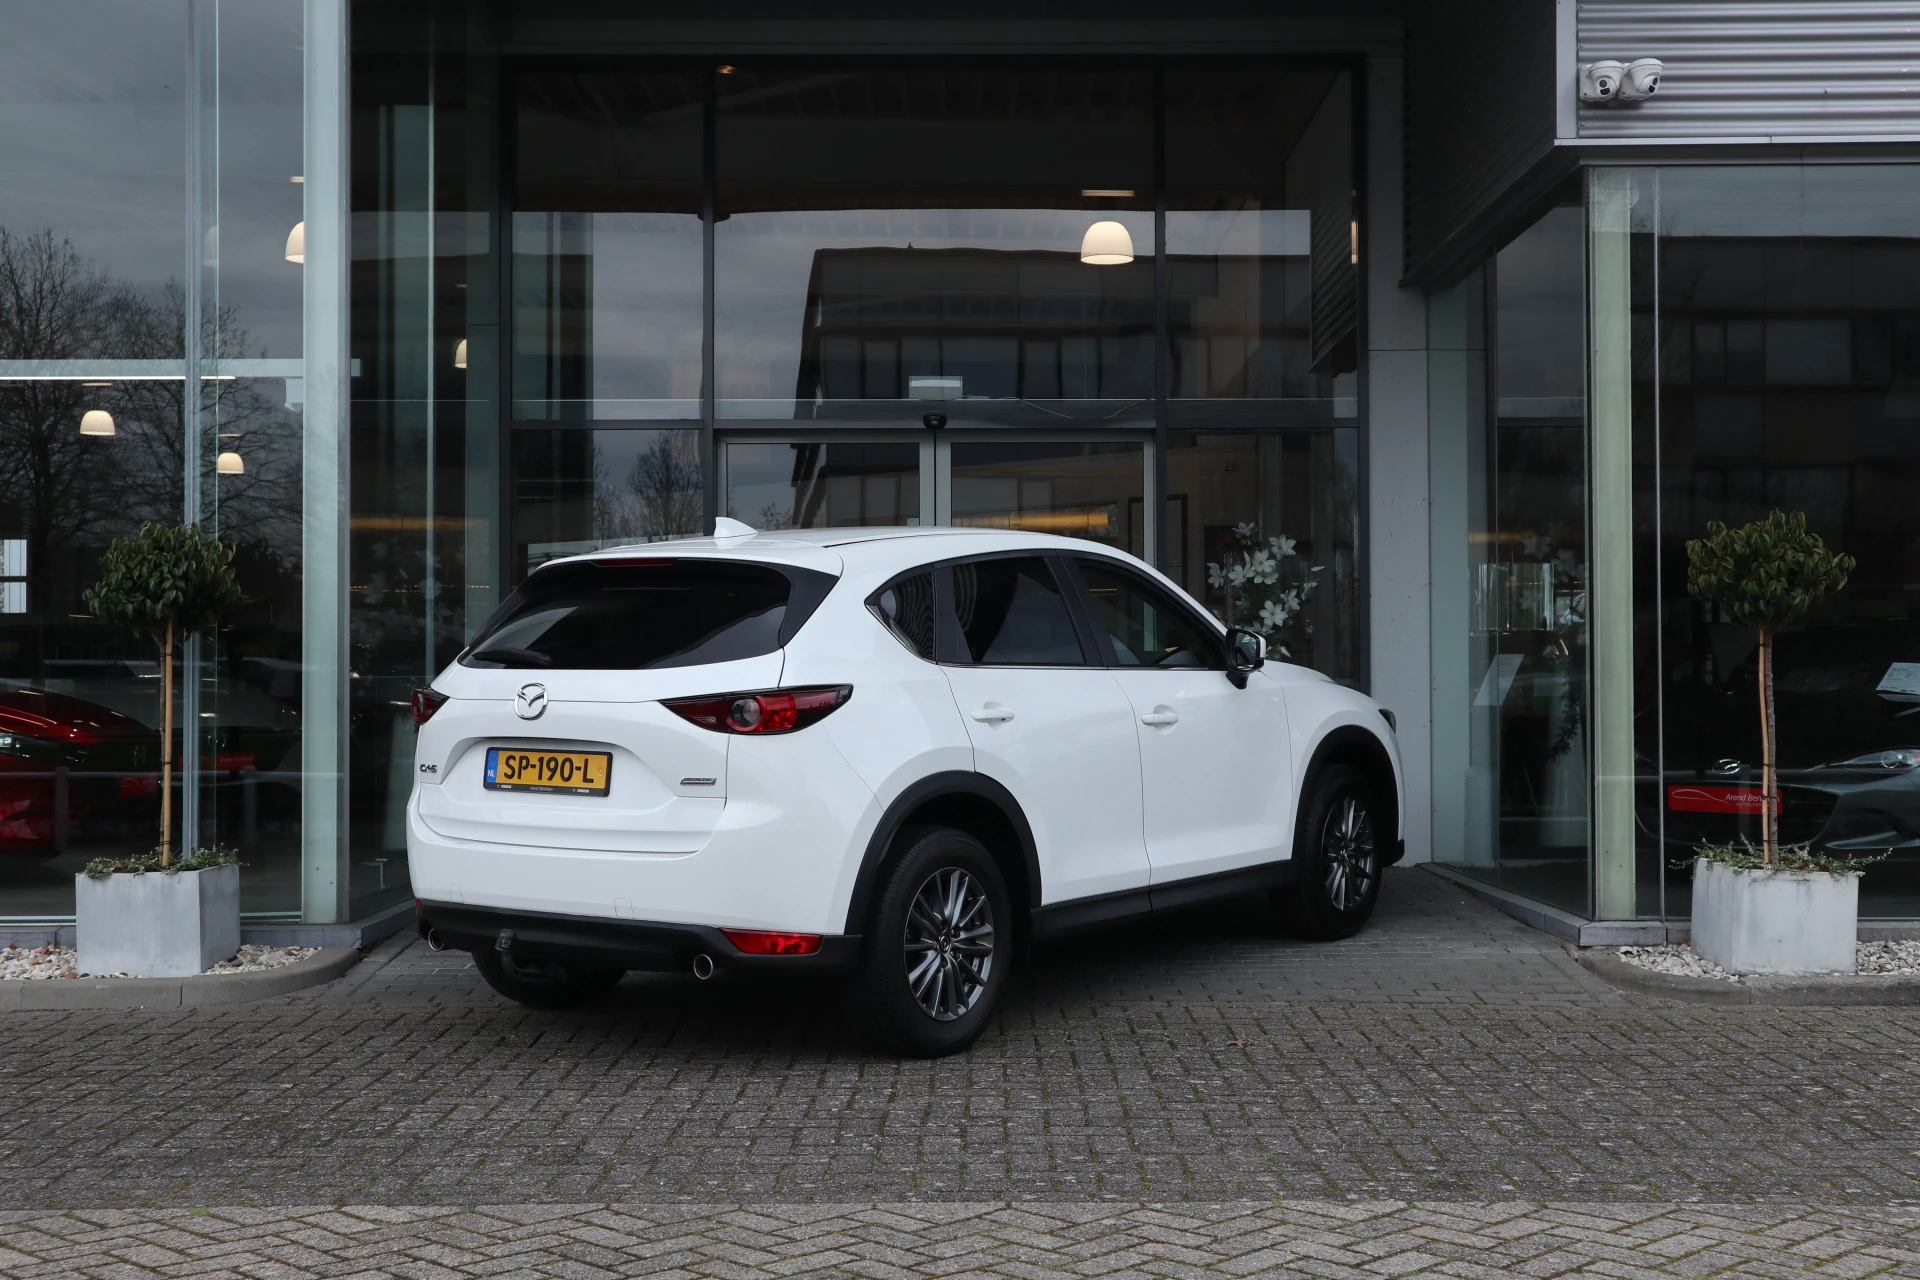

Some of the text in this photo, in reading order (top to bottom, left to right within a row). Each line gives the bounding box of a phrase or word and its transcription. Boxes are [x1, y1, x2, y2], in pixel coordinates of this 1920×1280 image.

[488, 769, 495, 778] NL
[503, 755, 594, 783] SP-190-L
[1725, 793, 1746, 801] Arend
